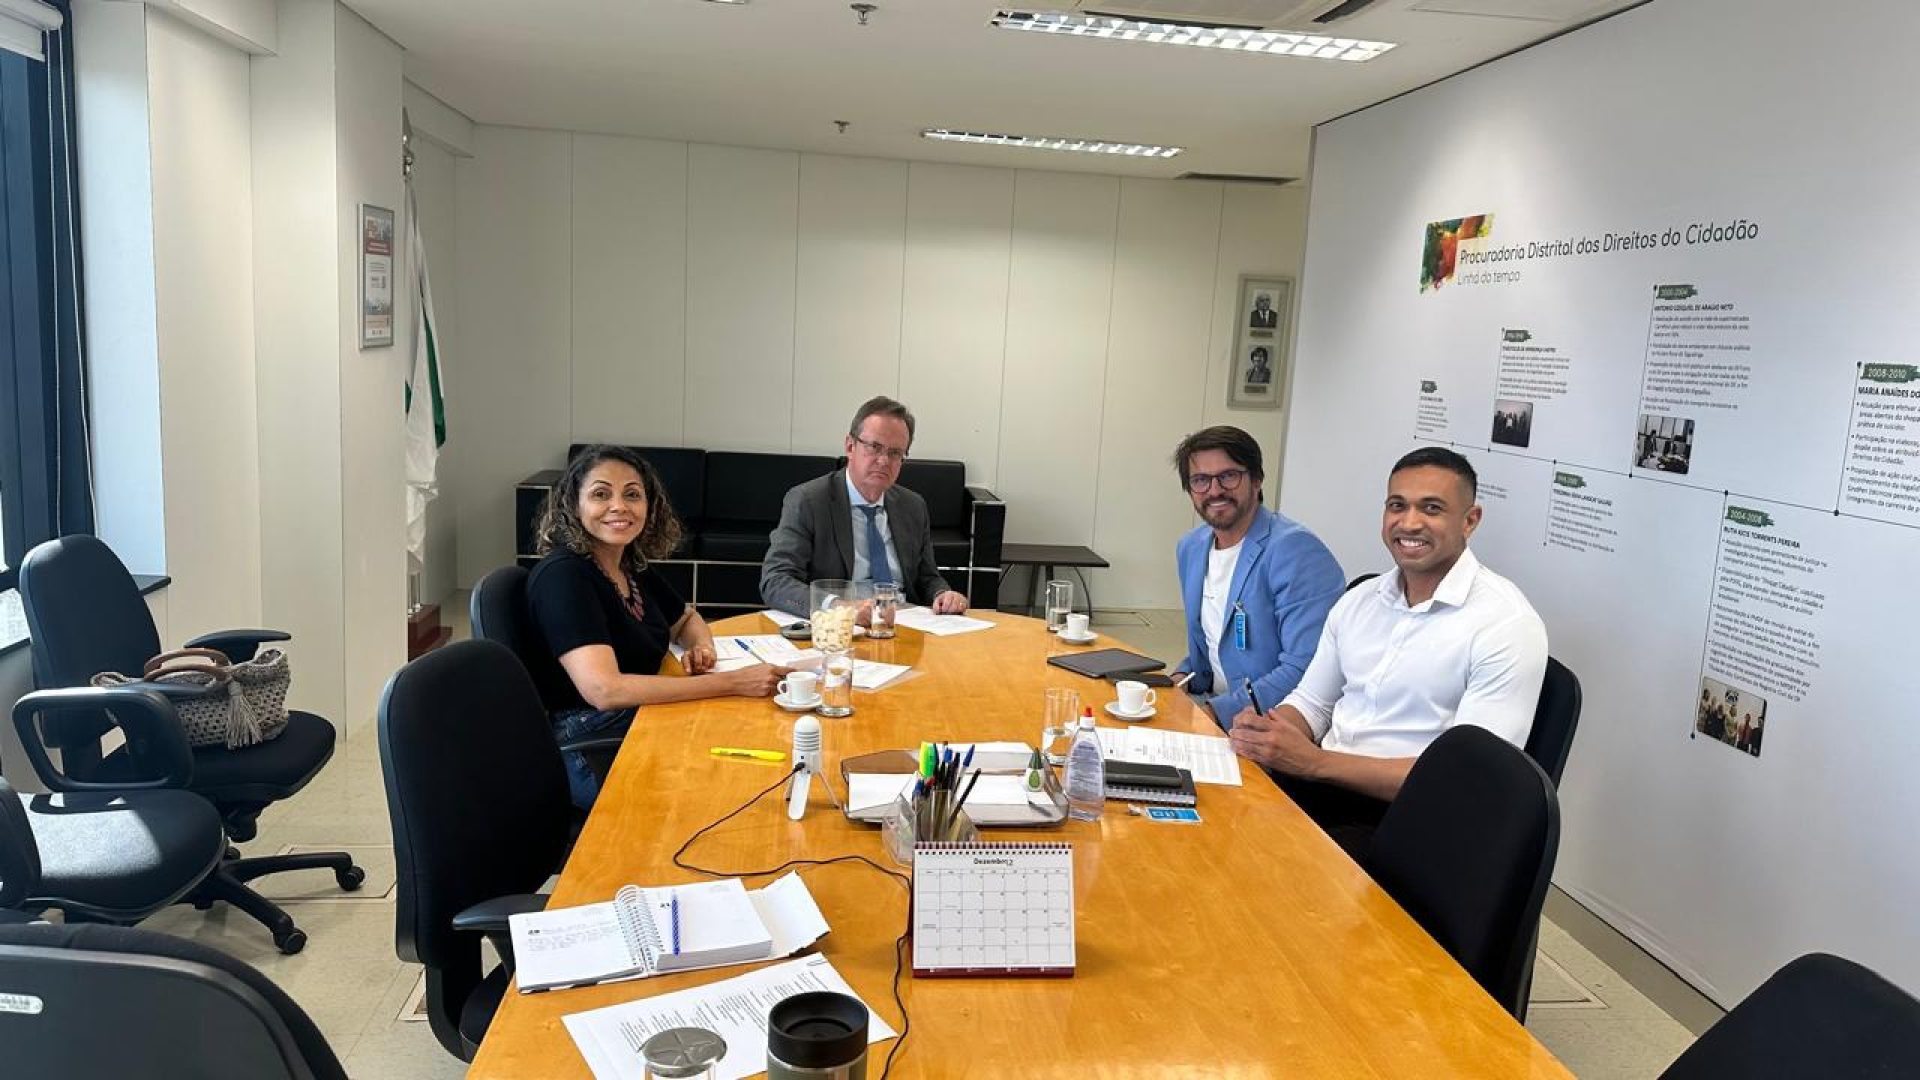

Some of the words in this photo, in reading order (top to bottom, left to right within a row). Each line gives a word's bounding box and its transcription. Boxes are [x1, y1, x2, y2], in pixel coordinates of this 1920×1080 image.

[1460, 243, 1524, 264] Procuradoria
[1528, 238, 1573, 259] Distrital
[1576, 236, 1599, 253] dos
[1603, 231, 1657, 252] Direitos
[1661, 228, 1681, 246] do
[1686, 219, 1758, 245] Cidadão
[1494, 270, 1520, 286] tempo
[1868, 368, 1907, 379] 2008-2010
[1858, 386, 1879, 395] MARIA
[1880, 387, 1909, 397] ANAÍDES
